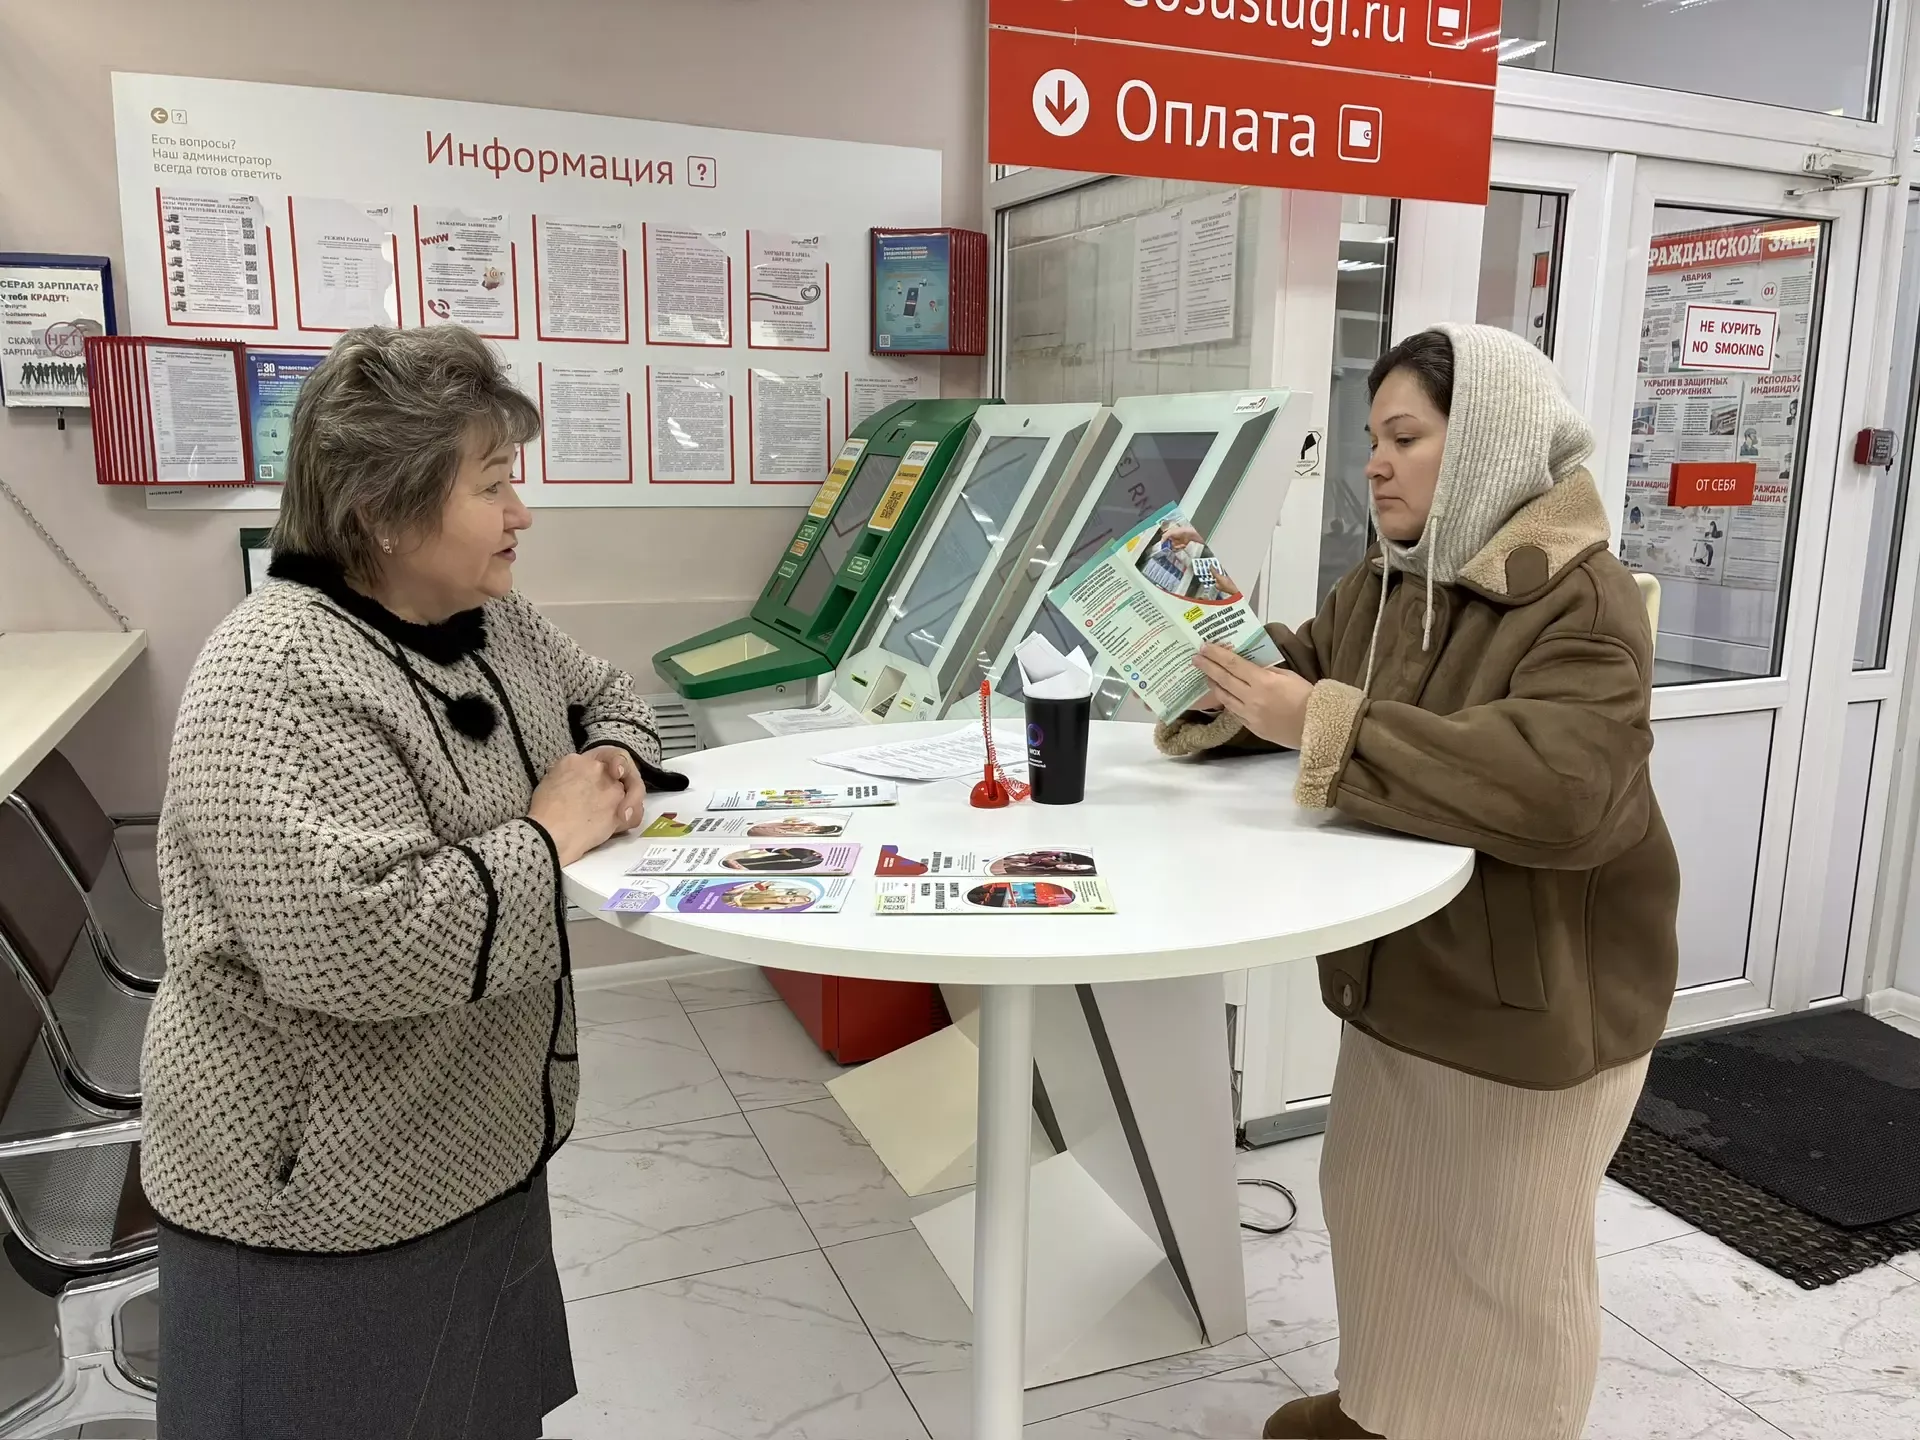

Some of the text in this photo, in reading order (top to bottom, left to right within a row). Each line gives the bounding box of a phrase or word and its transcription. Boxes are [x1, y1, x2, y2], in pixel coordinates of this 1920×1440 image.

[1125, 0, 1405, 46] uslugi.ru
[1116, 79, 1315, 157] Оплата
[151, 134, 236, 150] Есть вопросы?
[152, 148, 272, 168] Наш администратор
[426, 130, 674, 187] Информация
[153, 163, 282, 180] всегда готов ответить
[1767, 231, 1815, 253] ЗАЩ
[1680, 271, 1712, 283] АВАРИЯ
[0, 280, 99, 292] СЕРАЯ ЗАРПЛАТА?
[1763, 286, 1775, 297] 01
[8, 293, 28, 301] тебя
[31, 293, 70, 303] КРАДУТ:
[1700, 319, 1762, 336] НЕ КУРИТЬ
[8, 336, 41, 345] СКАЖИ
[3, 348, 48, 356] ЗАРПЛАТЕ
[1692, 340, 1765, 357] NO SMOKING
[263, 362, 276, 373] 30
[1643, 378, 1677, 388] УКРЫТИЕ
[1683, 377, 1728, 387] ЗАЩИТНЫХ
[1655, 386, 1712, 396] СООРУЖЕНИЯХ
[1695, 478, 1736, 492] ОТ СЕБЯ
[1752, 494, 1781, 504] АЩИТА
